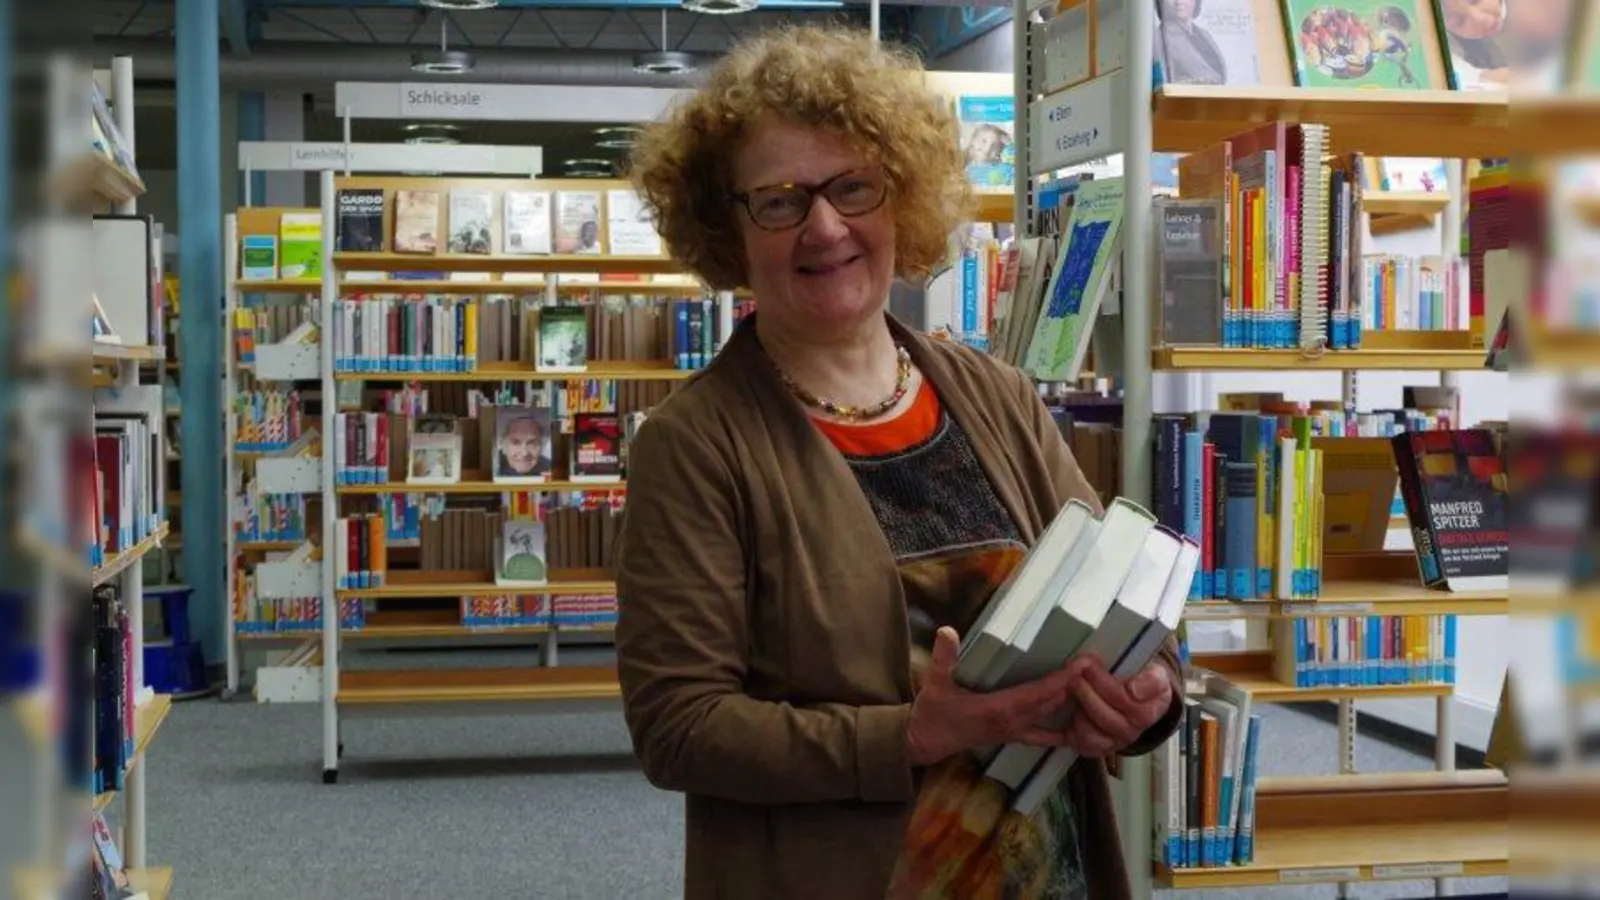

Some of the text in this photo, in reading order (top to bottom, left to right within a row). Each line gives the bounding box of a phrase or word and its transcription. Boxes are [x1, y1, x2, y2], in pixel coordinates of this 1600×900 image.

[407, 89, 481, 105] Schicksale
[340, 195, 382, 205] GARBO
[1430, 500, 1484, 516] MANFRED
[1433, 515, 1481, 530] SPITZER
